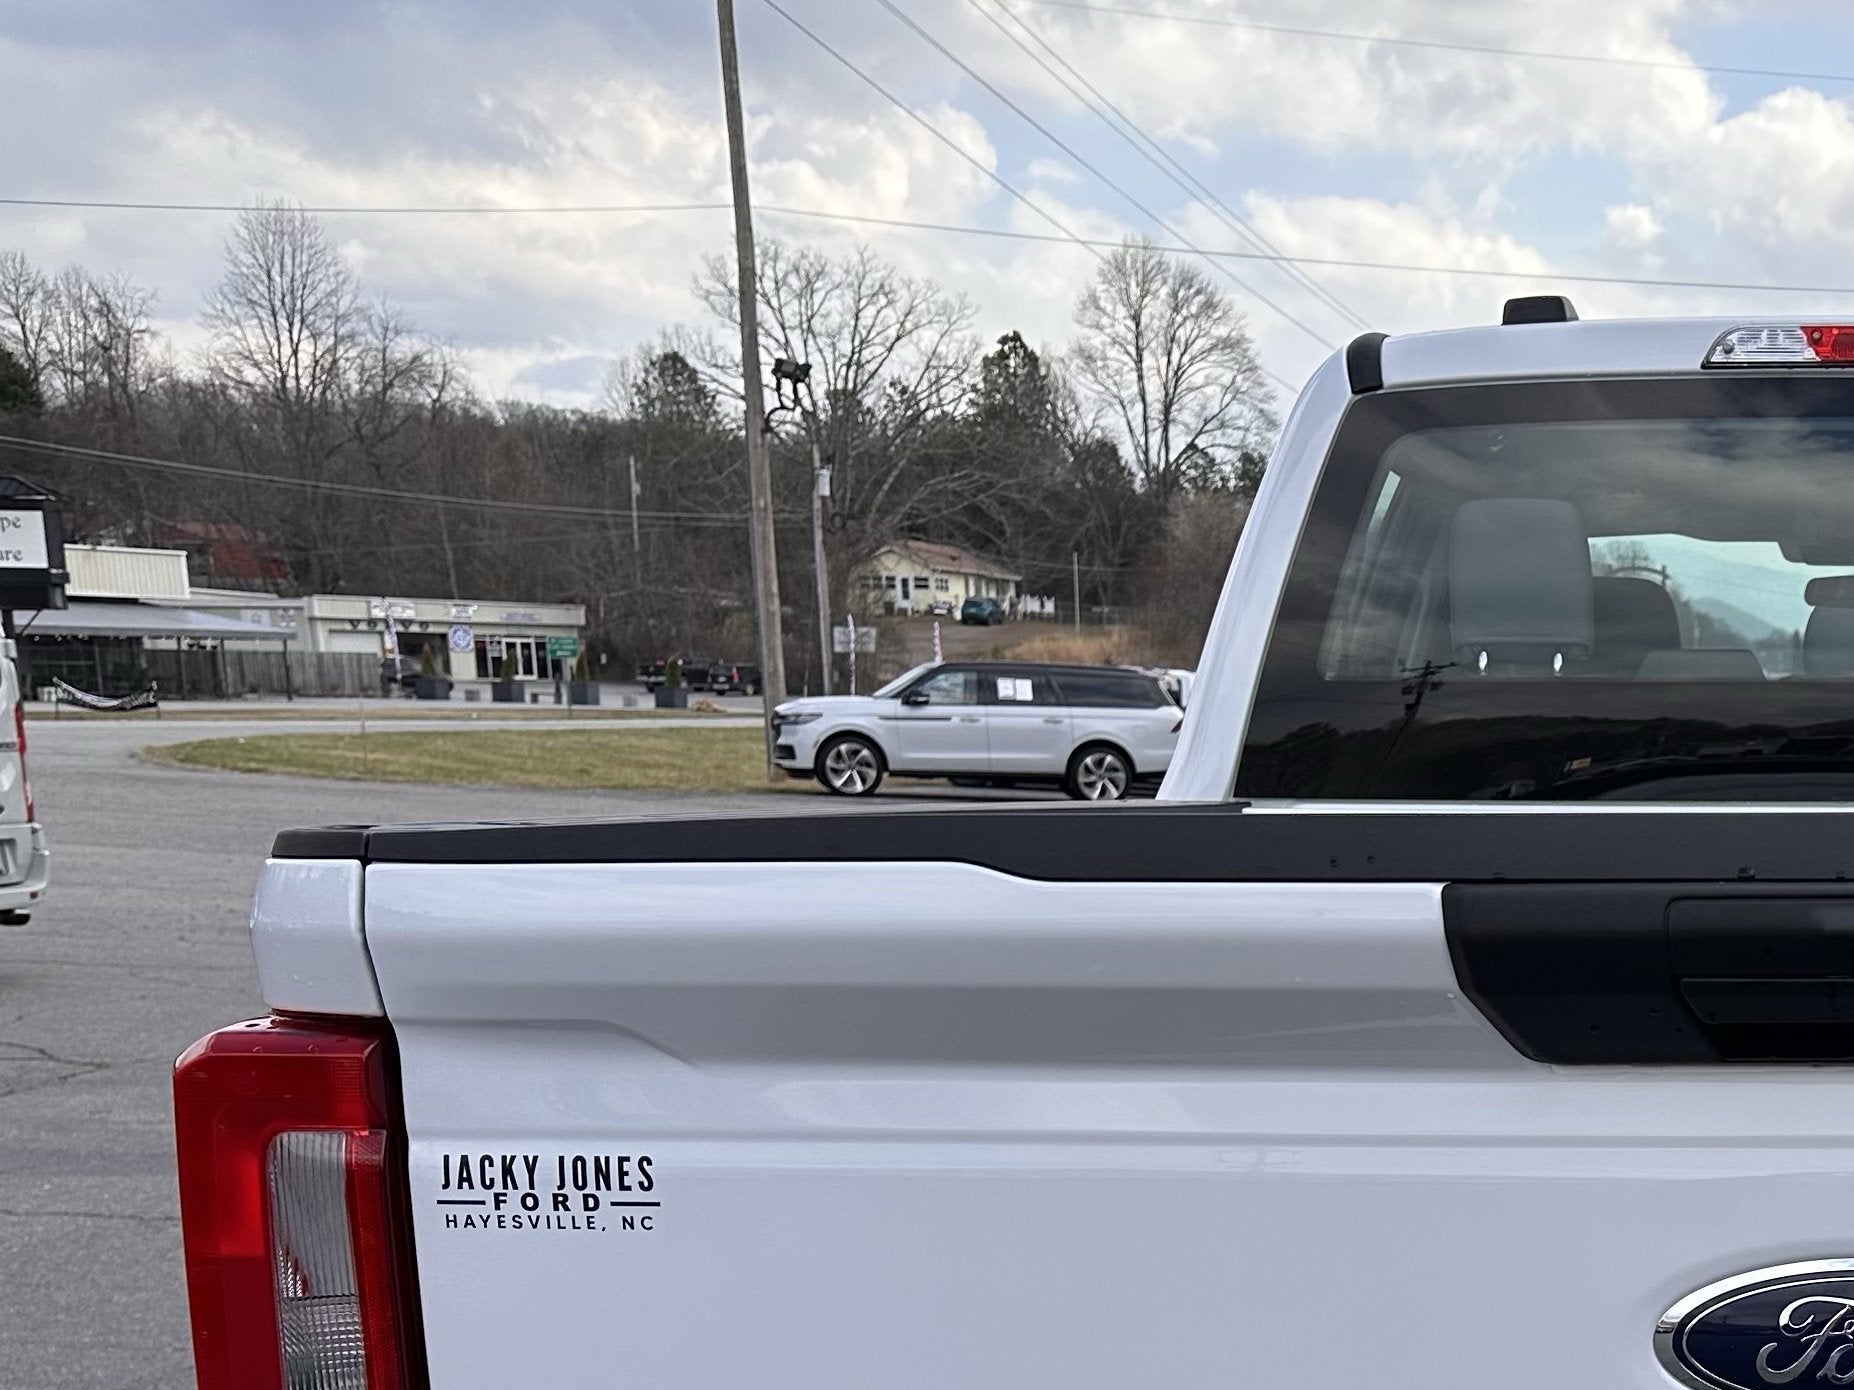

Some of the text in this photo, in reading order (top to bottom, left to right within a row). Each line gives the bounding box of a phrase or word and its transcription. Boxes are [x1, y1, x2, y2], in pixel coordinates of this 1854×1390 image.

[442, 1154, 654, 1192] JACKY JONES
[493, 1192, 601, 1212] FORD
[445, 1213, 654, 1232] HAYESVILLE, NC
